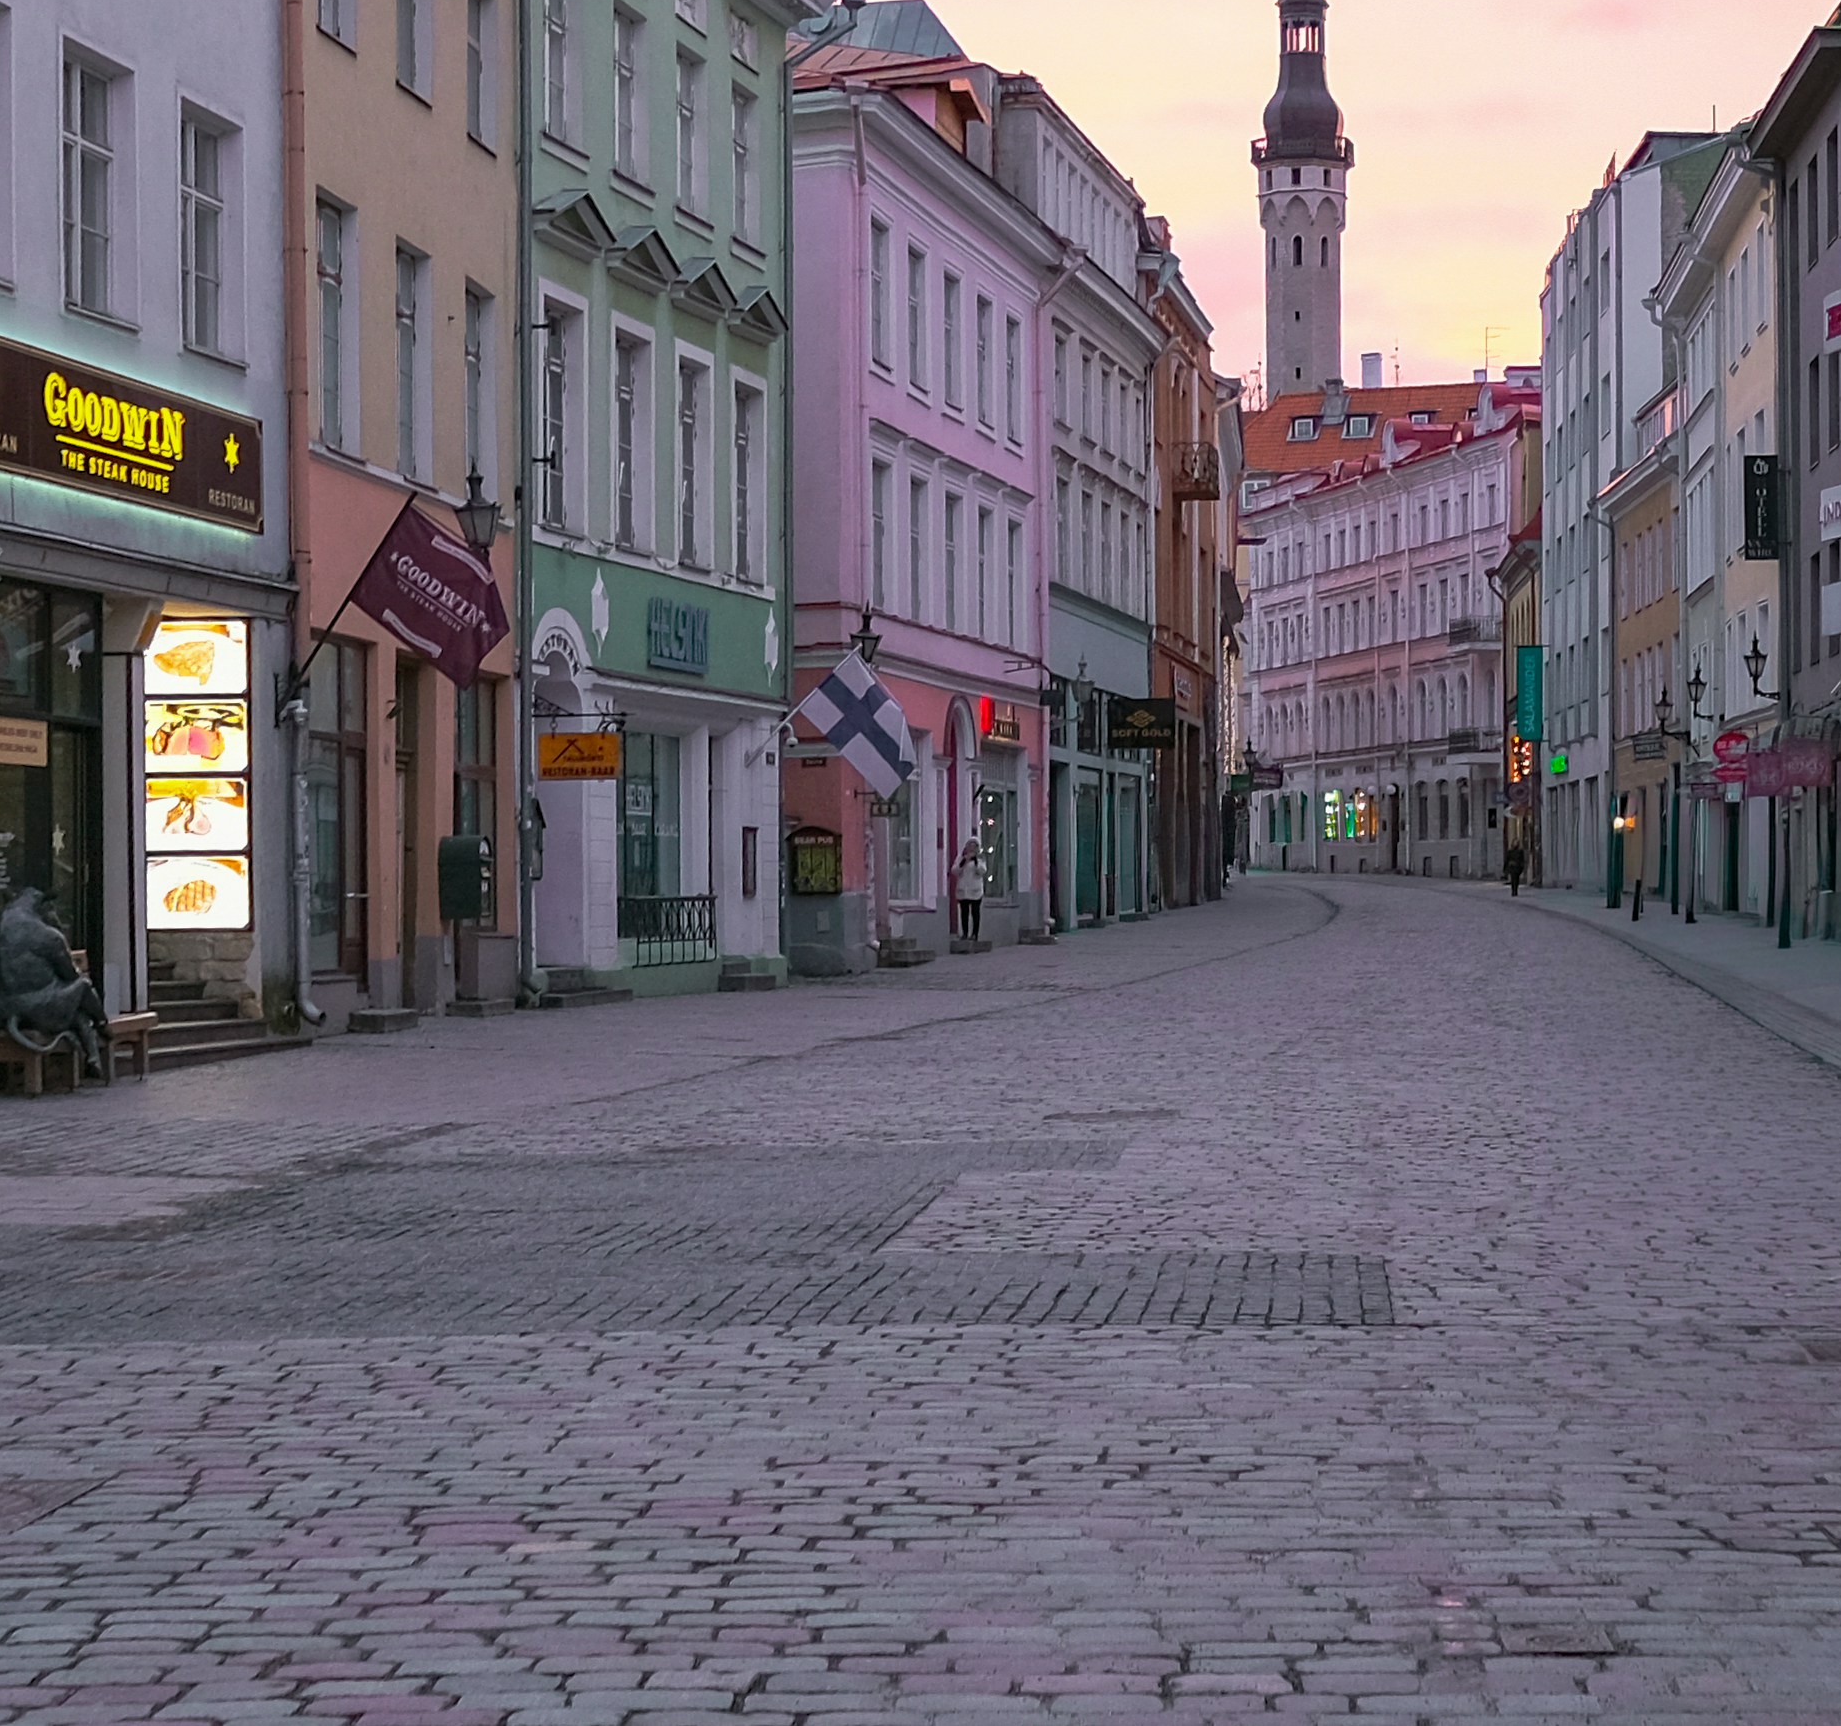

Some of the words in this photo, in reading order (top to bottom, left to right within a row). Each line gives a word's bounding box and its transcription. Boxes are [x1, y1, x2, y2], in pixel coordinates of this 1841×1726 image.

[44, 372, 186, 461] GOODWIN
[61, 449, 85, 471] THE
[89, 456, 128, 483] STEAK
[131, 468, 170, 493] HOUSE
[208, 488, 255, 515] RESTORAN
[397, 555, 486, 628] GOODWIN
[1112, 729, 1139, 737] SOFT
[1142, 729, 1171, 737] GOLD
